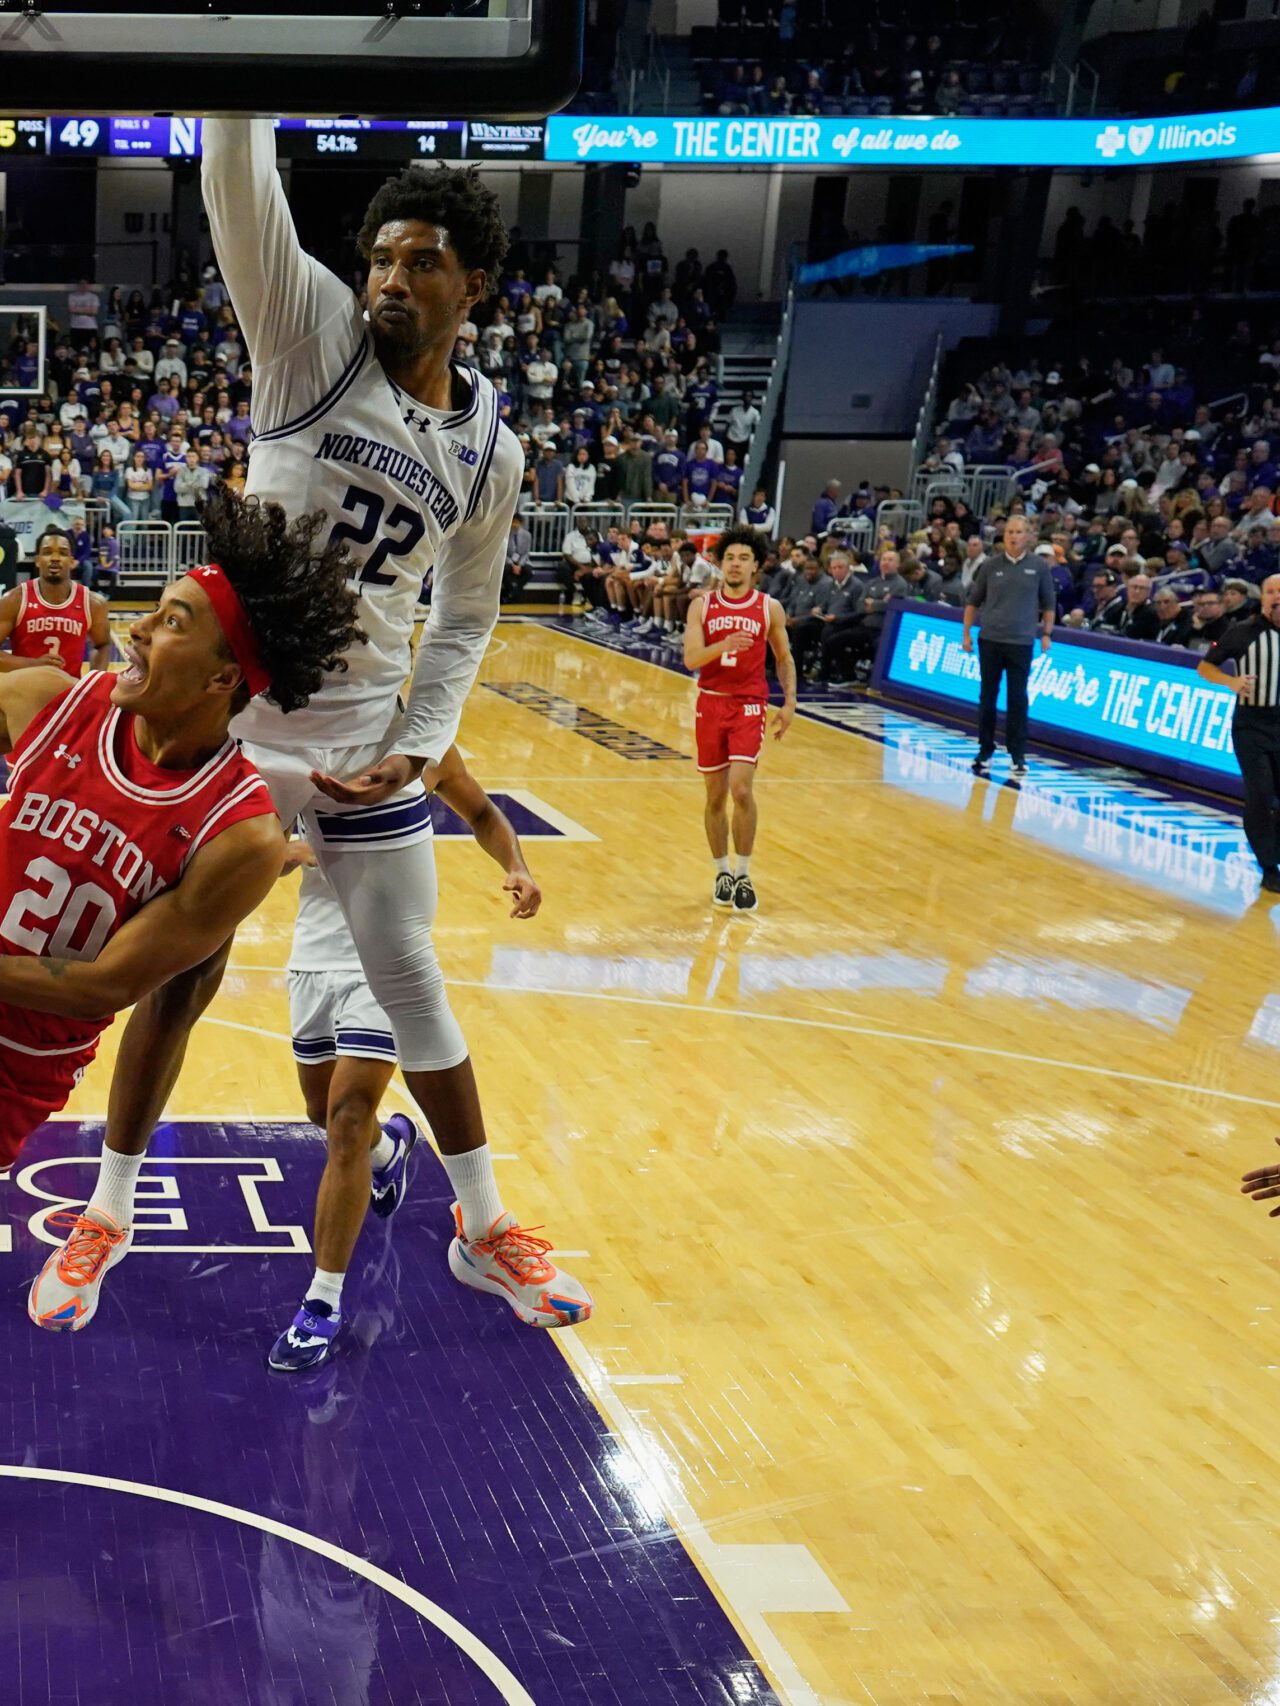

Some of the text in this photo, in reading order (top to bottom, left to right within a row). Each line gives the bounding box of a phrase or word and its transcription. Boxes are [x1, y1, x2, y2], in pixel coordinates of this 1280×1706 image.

[59, 119, 100, 147] 49
[170, 117, 195, 155] N
[316, 134, 358, 152] 54.1%
[417, 135, 436, 153] 14
[673, 122, 719, 157] THE
[725, 122, 820, 157] CENTER
[831, 127, 861, 153] of
[863, 128, 892, 151] all
[894, 134, 929, 152] we
[933, 130, 961, 151] do
[1157, 121, 1238, 151] Illinois
[314, 432, 459, 534] NORTHWESTERN
[326, 484, 426, 586] 22
[26, 616, 83, 636] BOSTON
[707, 615, 762, 637] BOSTON
[1101, 669, 1144, 729] THE
[9, 791, 167, 904] BOSTON
